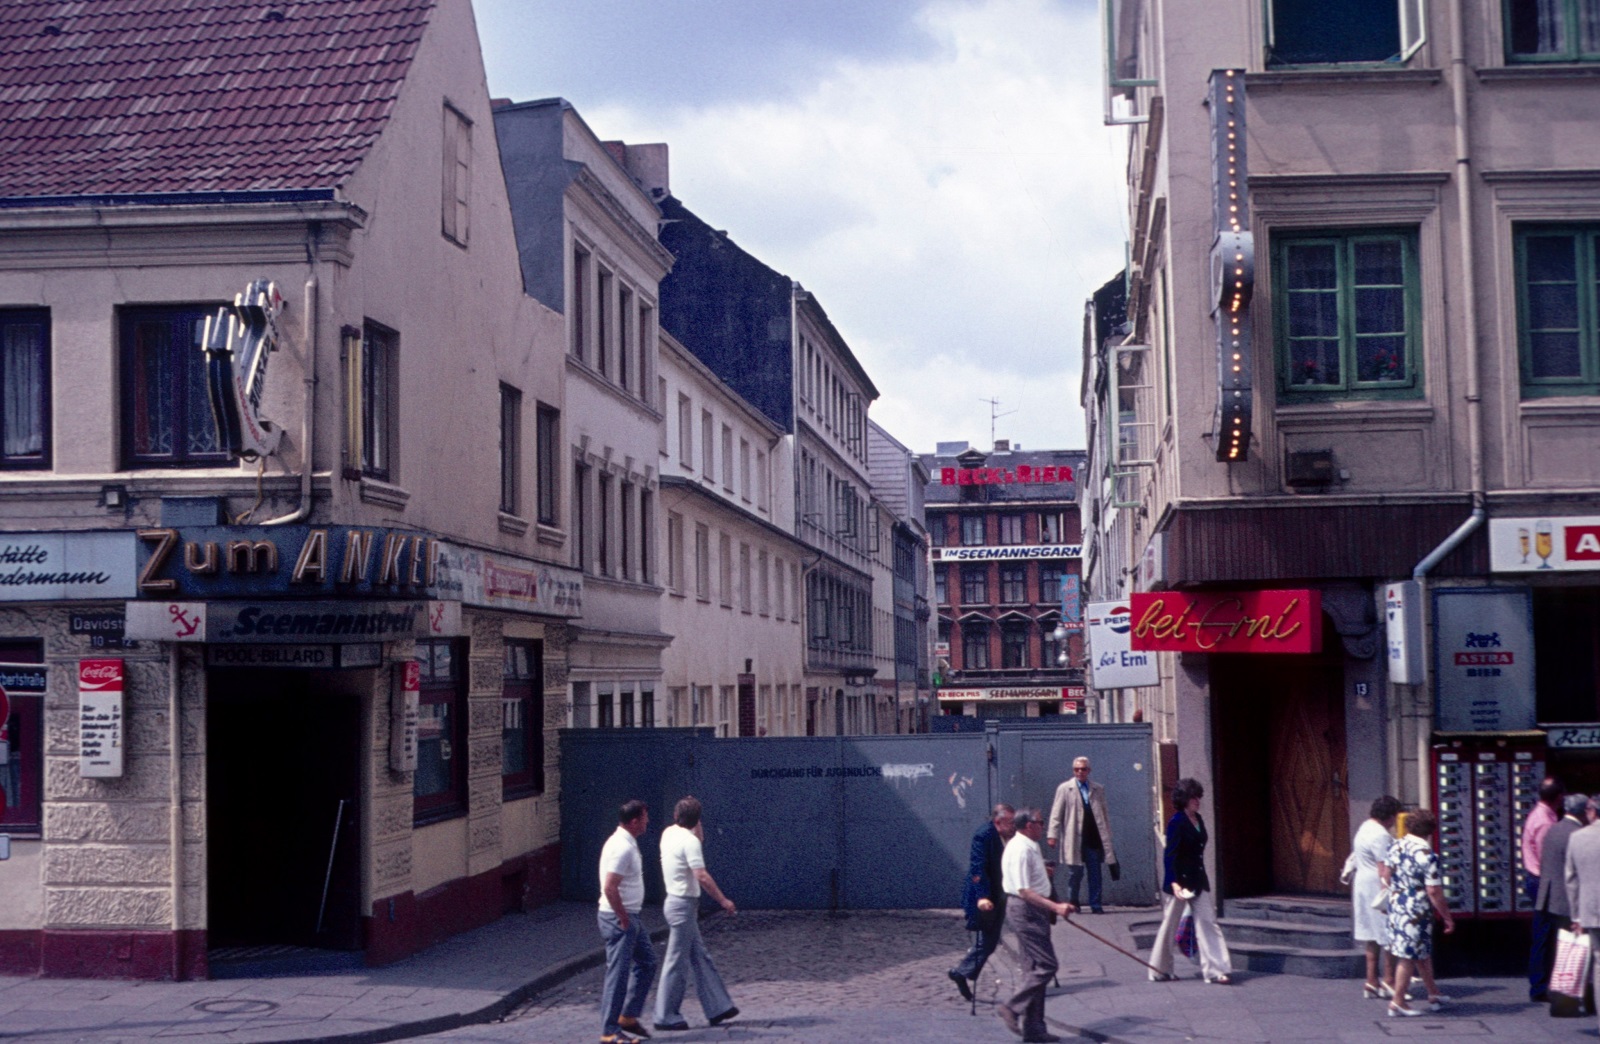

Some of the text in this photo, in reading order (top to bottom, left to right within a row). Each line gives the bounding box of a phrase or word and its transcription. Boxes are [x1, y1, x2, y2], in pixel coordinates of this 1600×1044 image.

[1016, 465, 1073, 483] BIER
[136, 528, 278, 591] Zum
[291, 529, 441, 588] ANKER
[958, 546, 1082, 560] SEEMANNSGARN
[73, 616, 127, 630] Davidst
[1104, 616, 1131, 625] PEP
[1133, 598, 1301, 650] bei Erni
[1121, 650, 1148, 667] Erni
[1458, 654, 1510, 664] ASTRA
[1466, 668, 1502, 677] BIER
[1356, 683, 1367, 695] 13
[807, 765, 823, 778] FÜR
